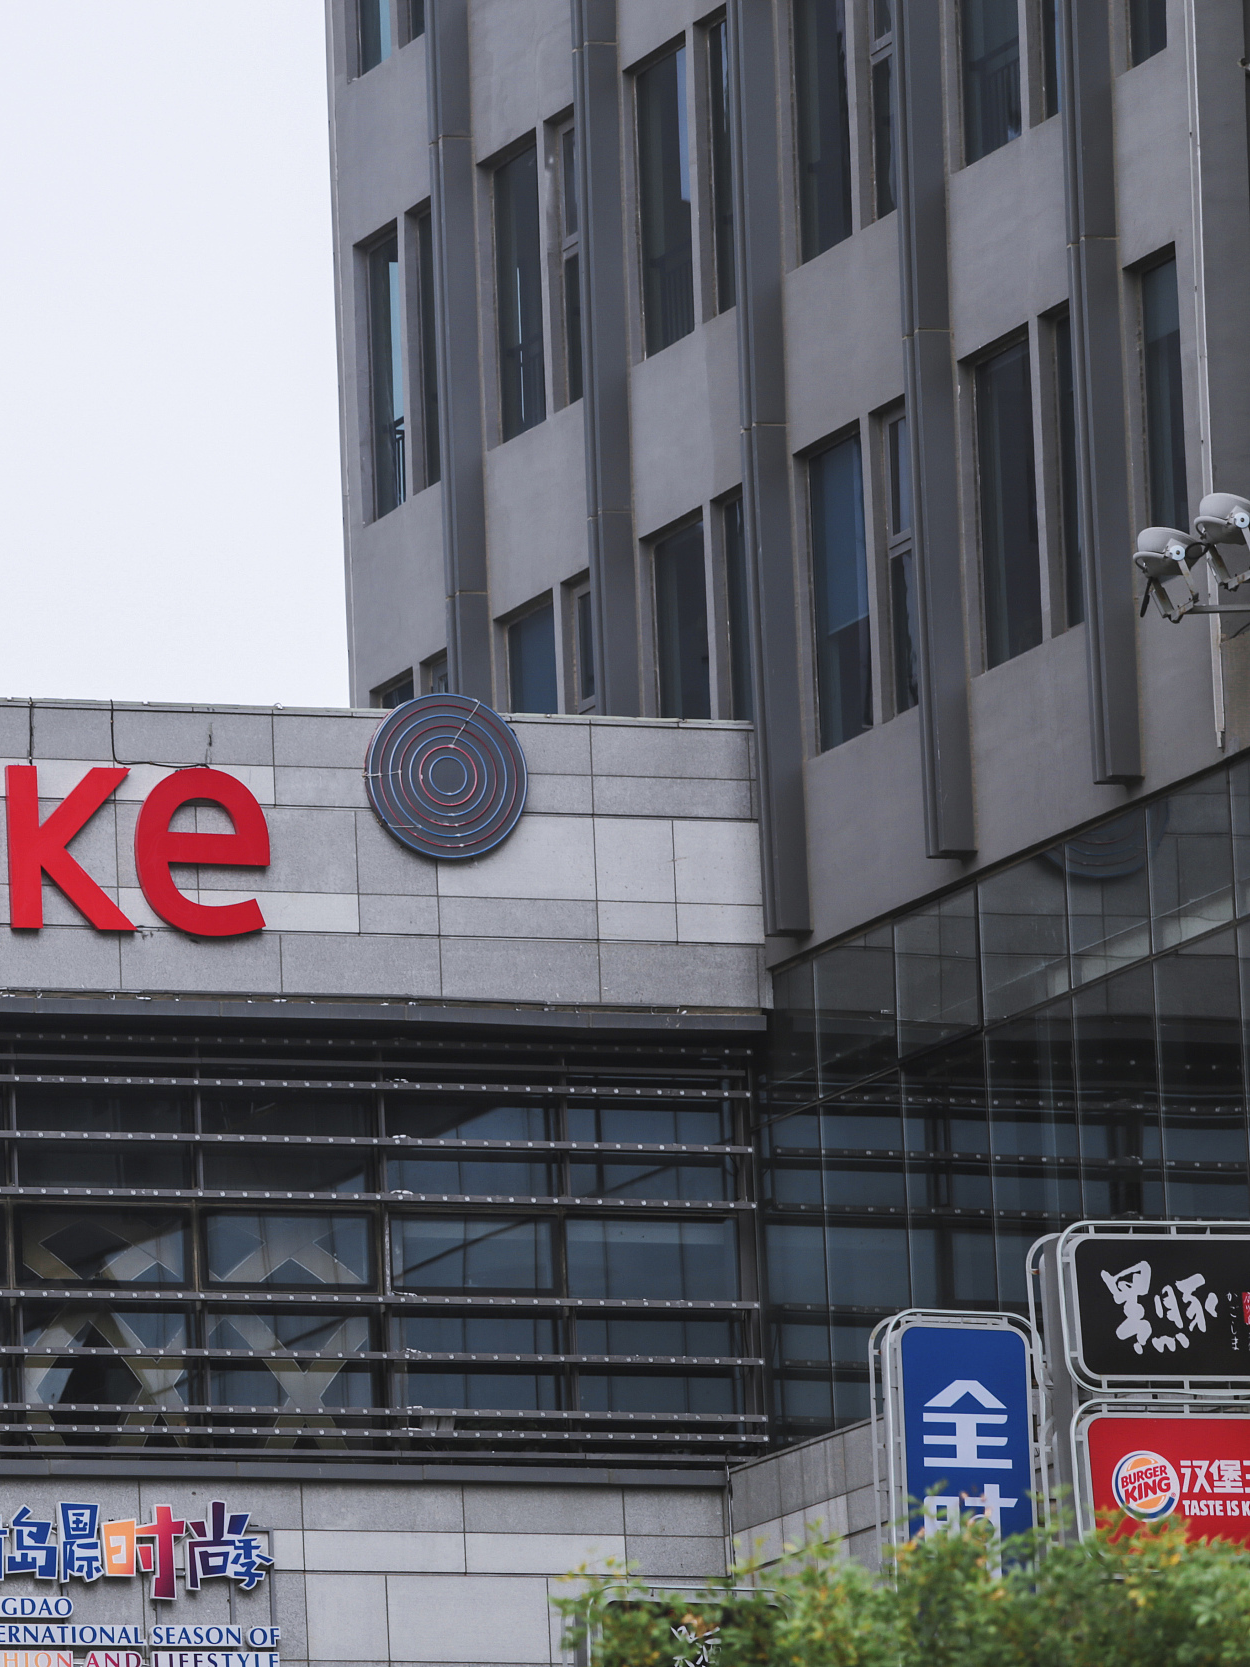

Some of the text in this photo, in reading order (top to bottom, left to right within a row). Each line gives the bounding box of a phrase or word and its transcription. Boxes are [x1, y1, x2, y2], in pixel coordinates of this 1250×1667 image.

[1120, 1465, 1168, 1489] BURGER
[1124, 1476, 1171, 1506] KING
[1182, 1500, 1225, 1516] TASTE
[1227, 1500, 1240, 1516] IS
[153, 1626, 242, 1645] SEASON
[250, 1627, 280, 1646] OF
[87, 1652, 141, 1667] AND
[154, 1653, 279, 1667] LIFESTYLE
